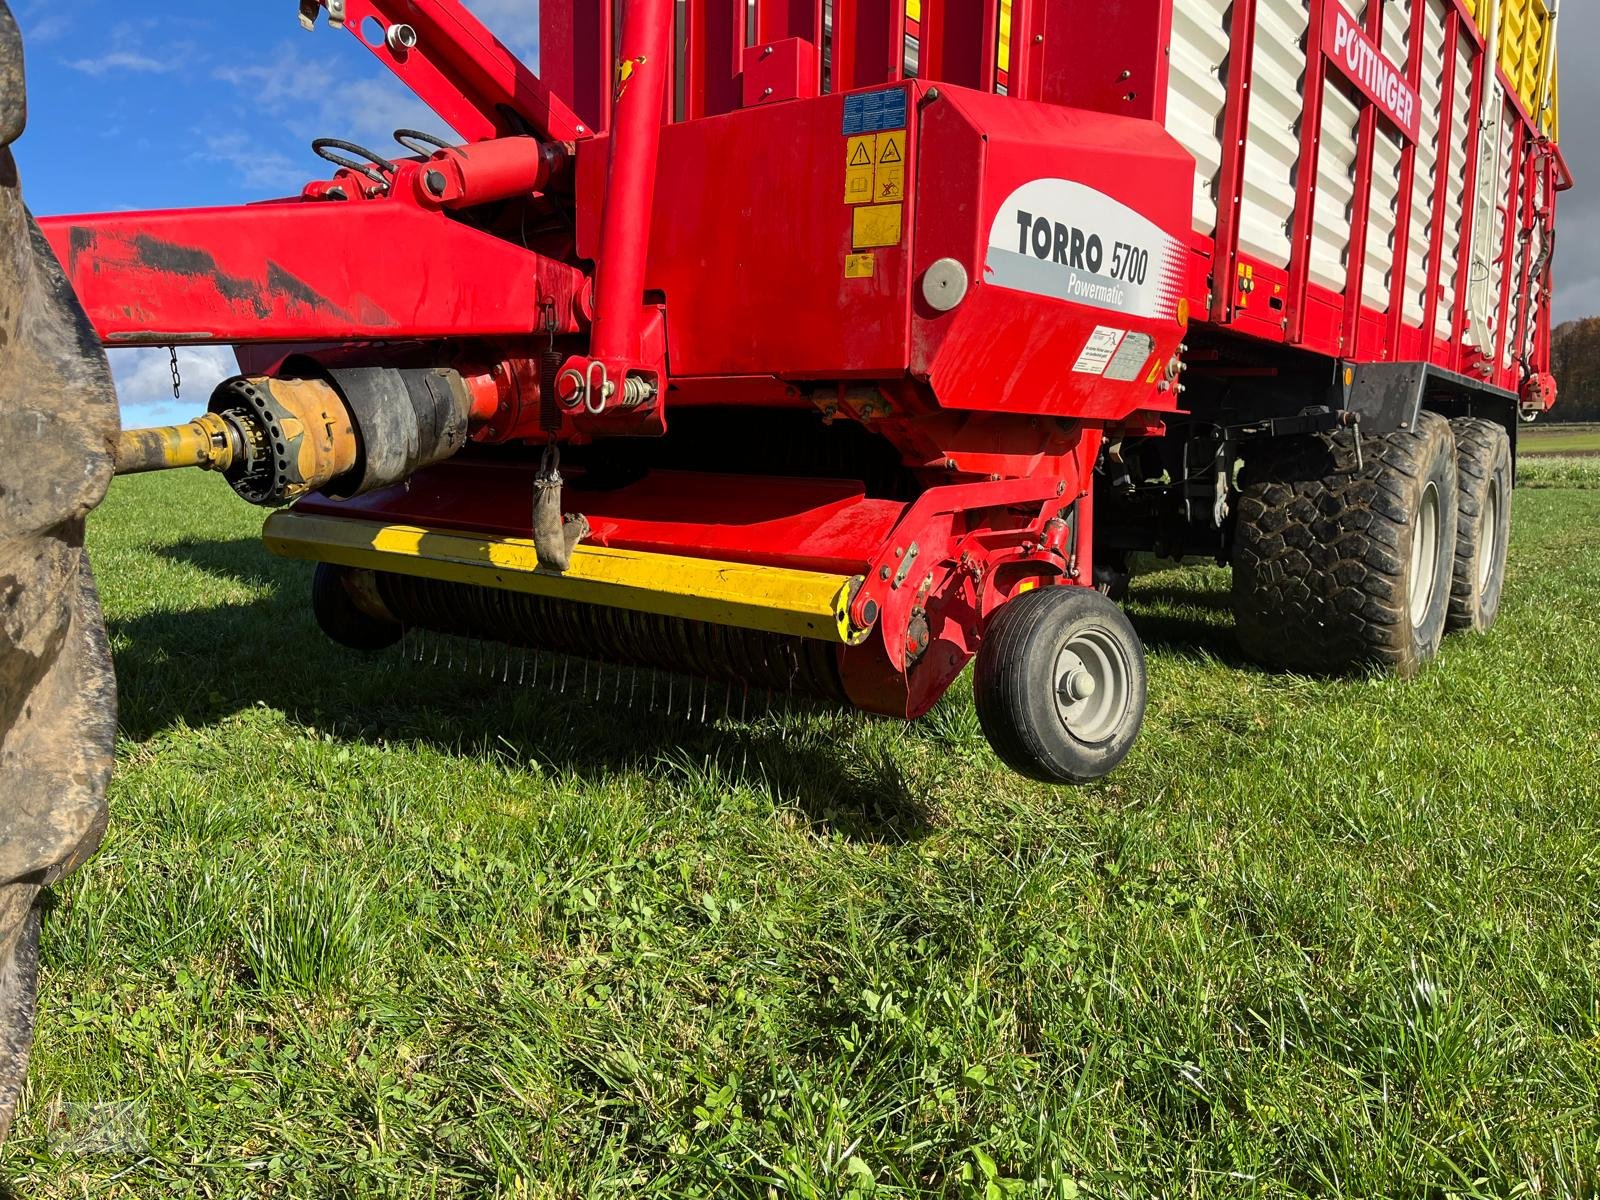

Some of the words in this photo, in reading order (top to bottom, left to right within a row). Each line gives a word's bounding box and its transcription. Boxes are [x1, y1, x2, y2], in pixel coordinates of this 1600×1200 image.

[1017, 210, 1103, 273] TORRO
[1111, 241, 1148, 285] 5700
[1067, 272, 1124, 307] Powermatic
